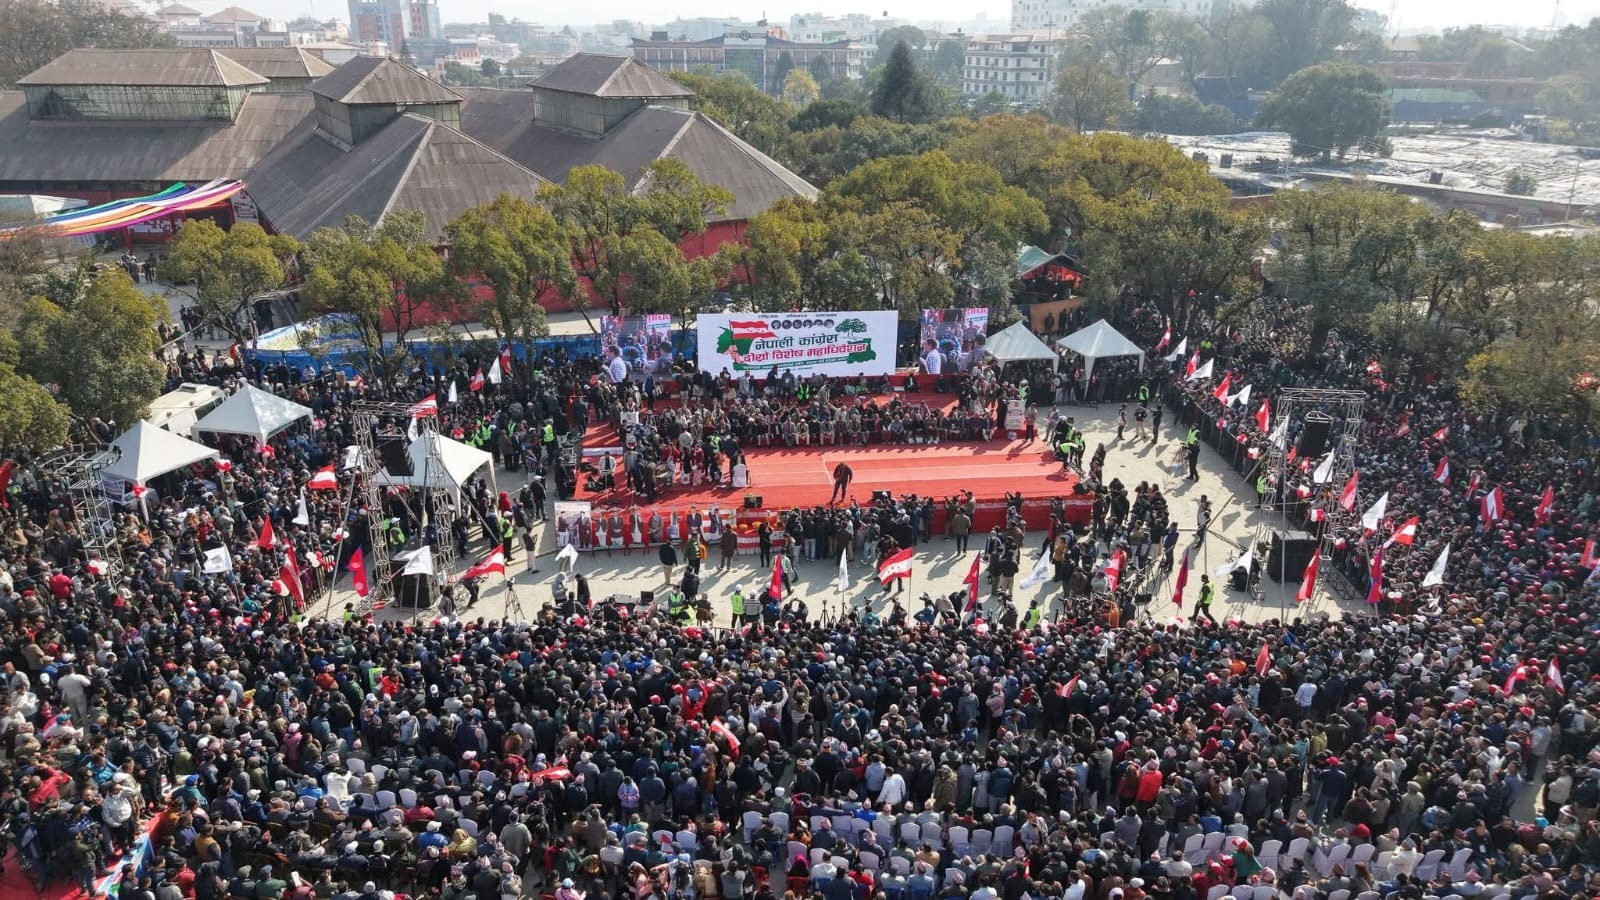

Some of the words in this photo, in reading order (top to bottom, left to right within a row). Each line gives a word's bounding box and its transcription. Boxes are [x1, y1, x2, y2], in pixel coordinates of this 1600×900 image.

[755, 336, 793, 350] नेपाली
[772, 348, 804, 360] विशेष
[807, 344, 866, 357] महाधिवेशन
